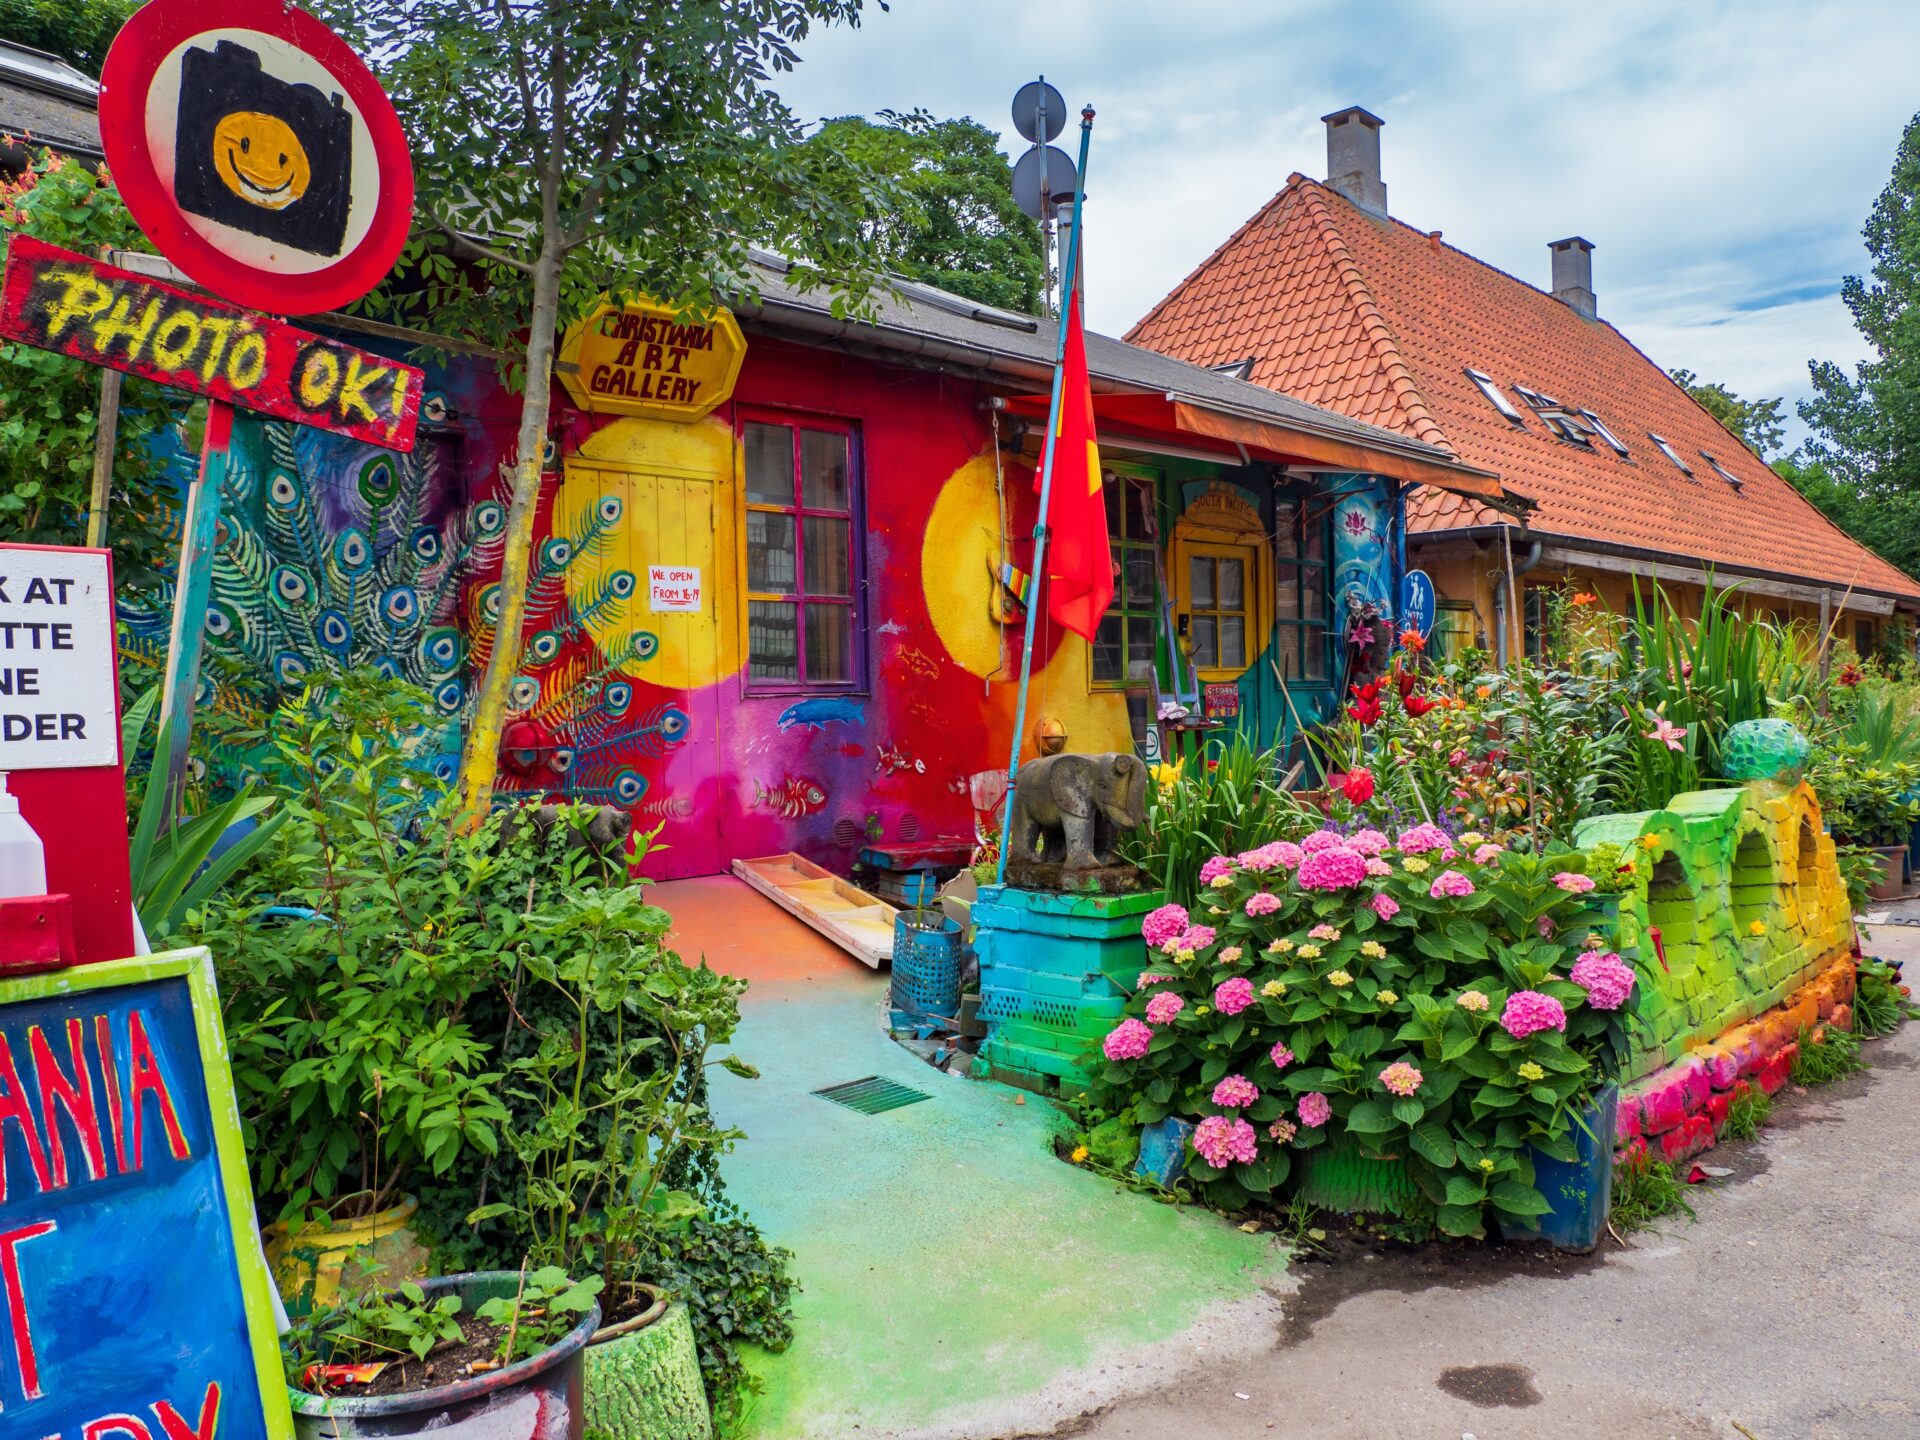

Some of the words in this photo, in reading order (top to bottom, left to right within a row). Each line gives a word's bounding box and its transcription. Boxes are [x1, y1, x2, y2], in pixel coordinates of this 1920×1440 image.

[38, 270, 267, 390] PHOTO
[613, 340, 690, 374] ART
[590, 364, 702, 403] GALLERY
[652, 569, 666, 580] WE
[669, 571, 693, 581] OPEN
[23, 577, 75, 605] AT
[653, 586, 679, 599] FROM
[3, 713, 88, 742] DER
